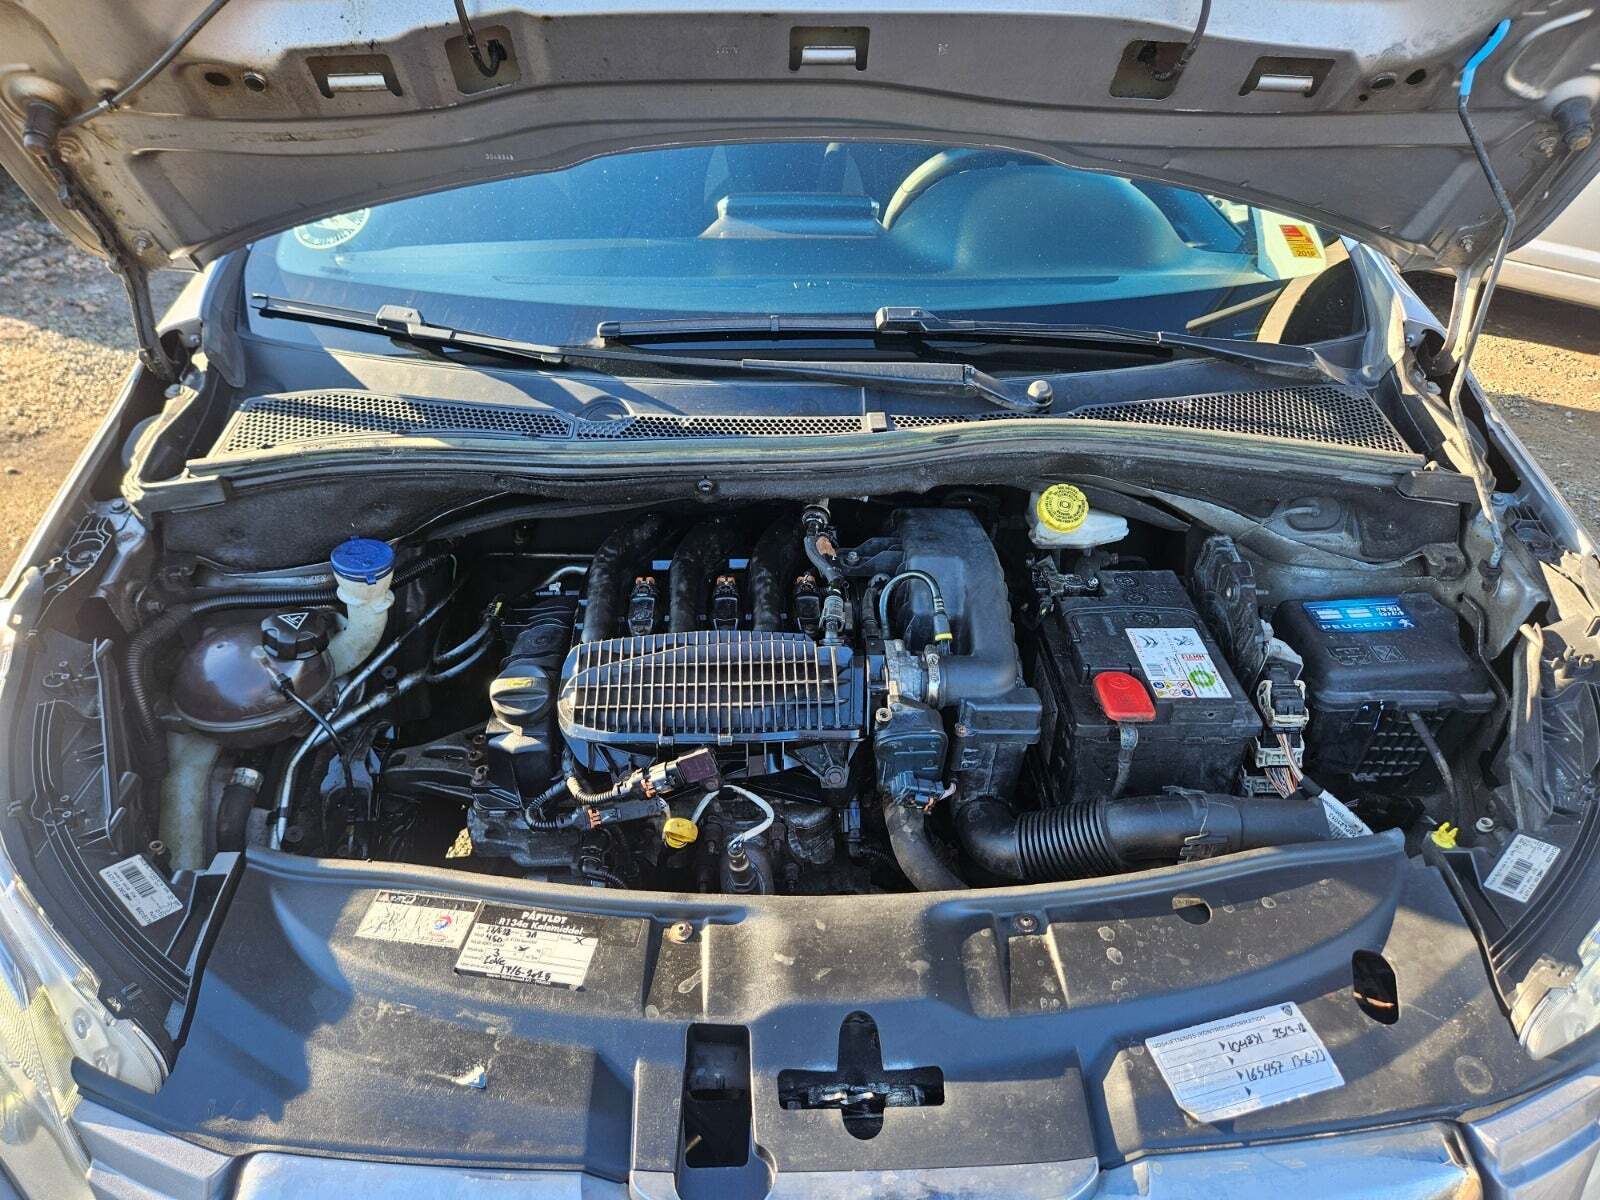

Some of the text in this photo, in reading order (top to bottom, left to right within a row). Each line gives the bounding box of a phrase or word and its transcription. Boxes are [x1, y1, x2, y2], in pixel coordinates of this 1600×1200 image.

[1321, 621, 1393, 630] PEUGEOT
[498, 917, 529, 929] R134a
[521, 911, 568, 924] PÅFYLDT
